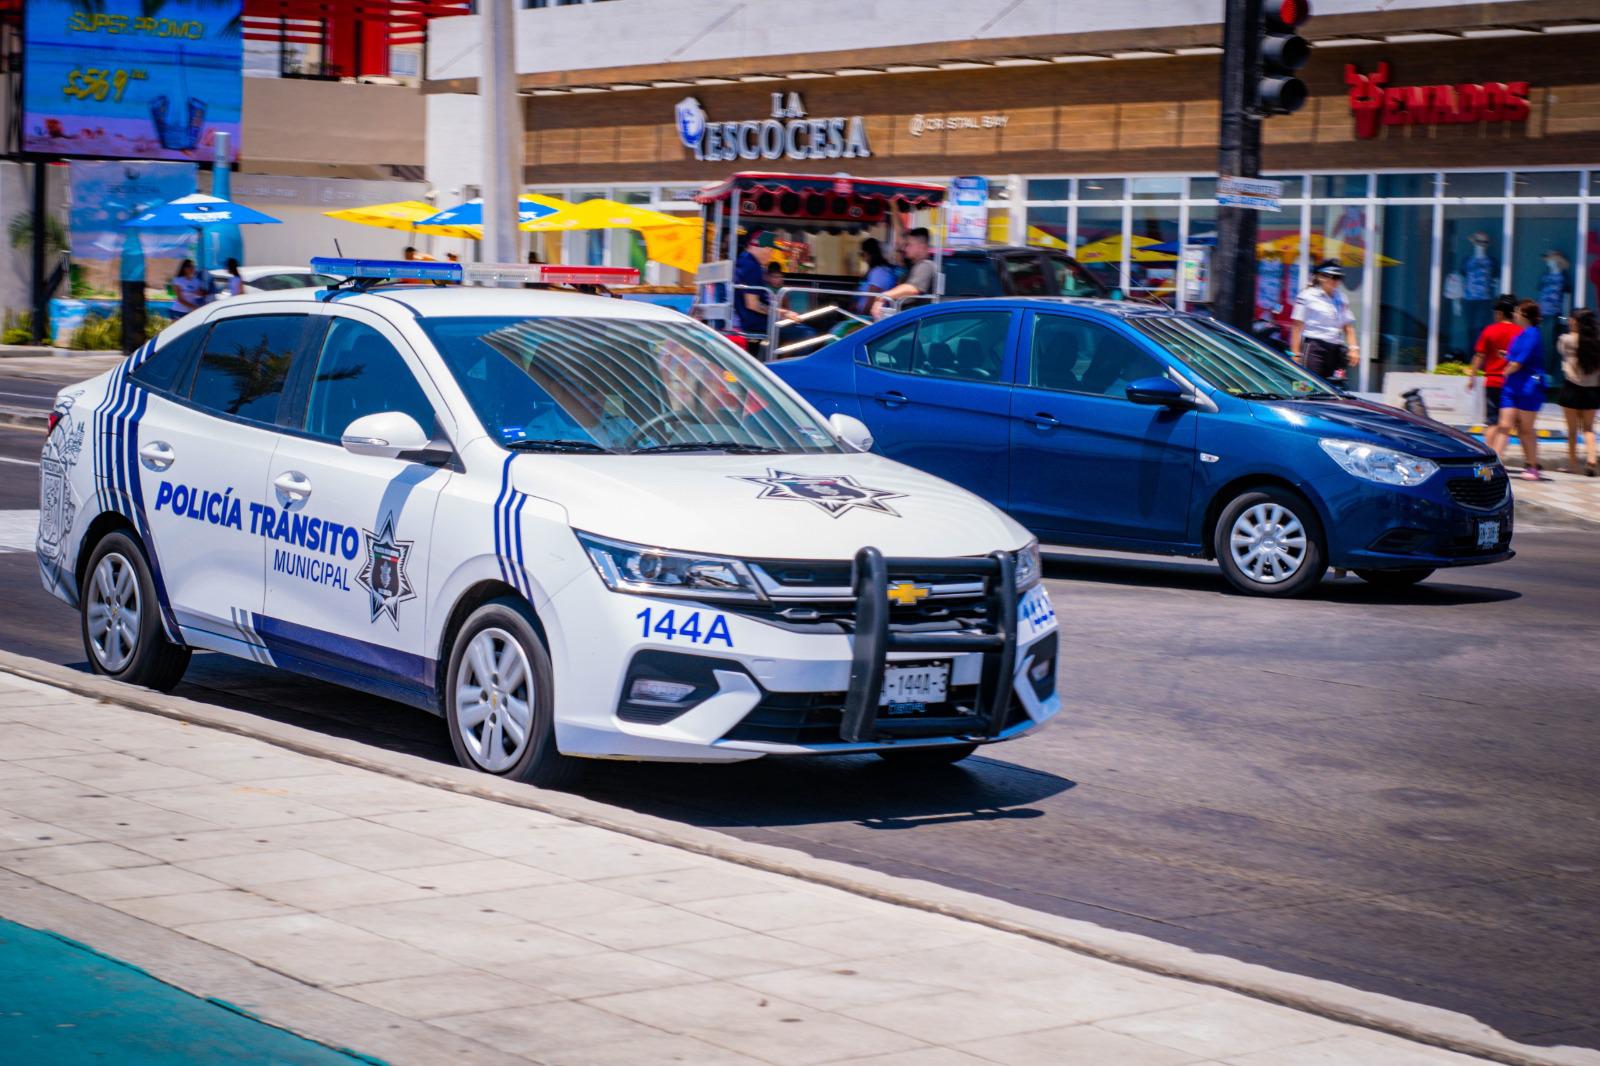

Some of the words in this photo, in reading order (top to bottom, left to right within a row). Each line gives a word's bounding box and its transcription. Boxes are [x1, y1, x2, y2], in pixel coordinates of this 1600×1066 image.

[67, 11, 130, 34] SUPE
[770, 91, 808, 118] LA
[703, 115, 872, 162] ESCOCESA
[154, 481, 243, 531] POLICÍA
[249, 502, 360, 561] TRÁNSITO
[273, 549, 350, 592] MUNICIPAL
[636, 607, 734, 648] 144A
